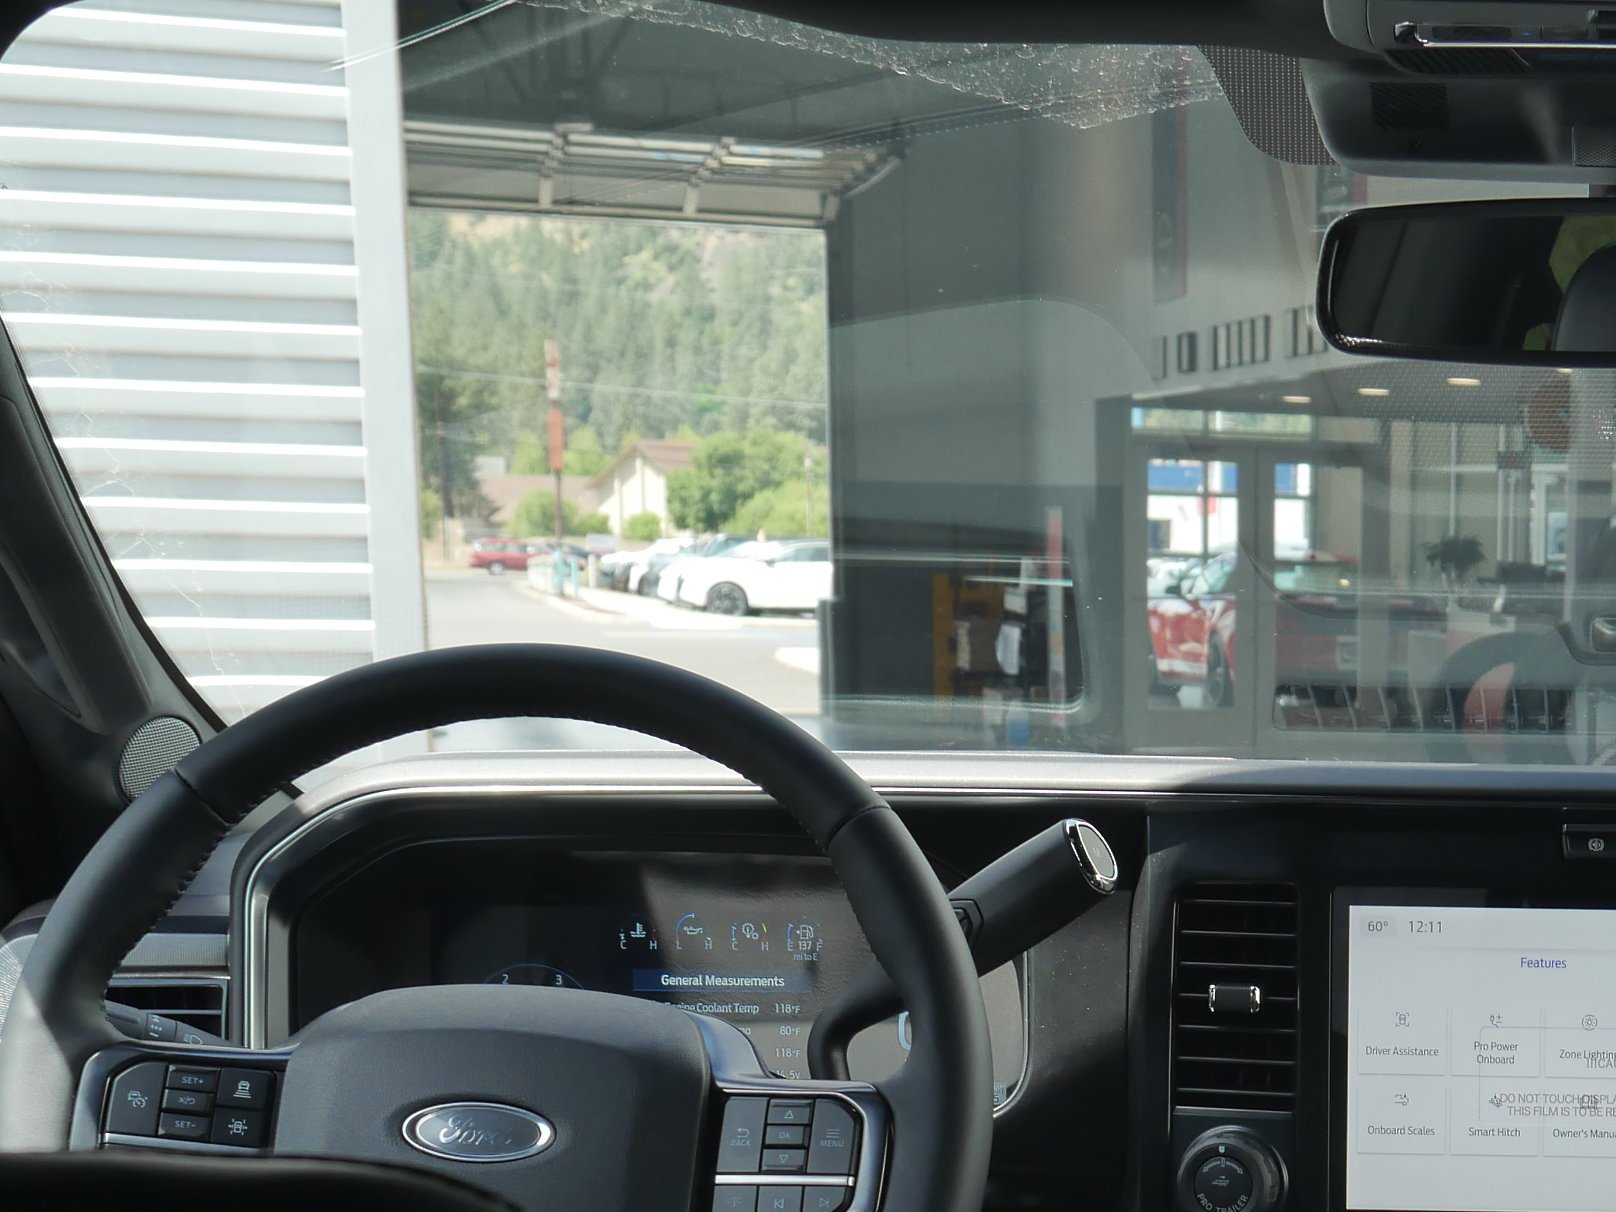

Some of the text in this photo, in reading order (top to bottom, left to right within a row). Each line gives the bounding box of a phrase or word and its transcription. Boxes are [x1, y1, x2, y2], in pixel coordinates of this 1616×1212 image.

[1367, 920, 1443, 934] 60° 12:11
[1520, 957, 1567, 969] Features
[502, 973, 509, 985] 2
[555, 974, 562, 985] 3
[661, 974, 785, 987] General Measurements
[696, 1002, 732, 1013] Coolant
[734, 1003, 760, 1015] Temp
[1365, 1045, 1439, 1057] Driver Assistance
[1473, 1041, 1519, 1052] Pro Power
[1476, 1054, 1515, 1065] Onboard
[1559, 1049, 1582, 1060] Zone
[1500, 1093, 1516, 1104] DO
[1518, 1093, 1541, 1104] NOT
[1542, 1093, 1580, 1105] TOUCH
[1508, 1105, 1531, 1116] THIS
[1533, 1106, 1558, 1117] FILM
[1560, 1106, 1570, 1117] IS
[1573, 1106, 1588, 1117] TO
[1589, 1107, 1603, 1118] BE
[1367, 1124, 1436, 1136] Onboard Scales
[1468, 1126, 1521, 1137] Smart Hitch
[1552, 1128, 1587, 1139] Owner's
[730, 1139, 751, 1147] BACK
[819, 1139, 844, 1148] MENU
[1196, 1193, 1213, 1211] PRO
